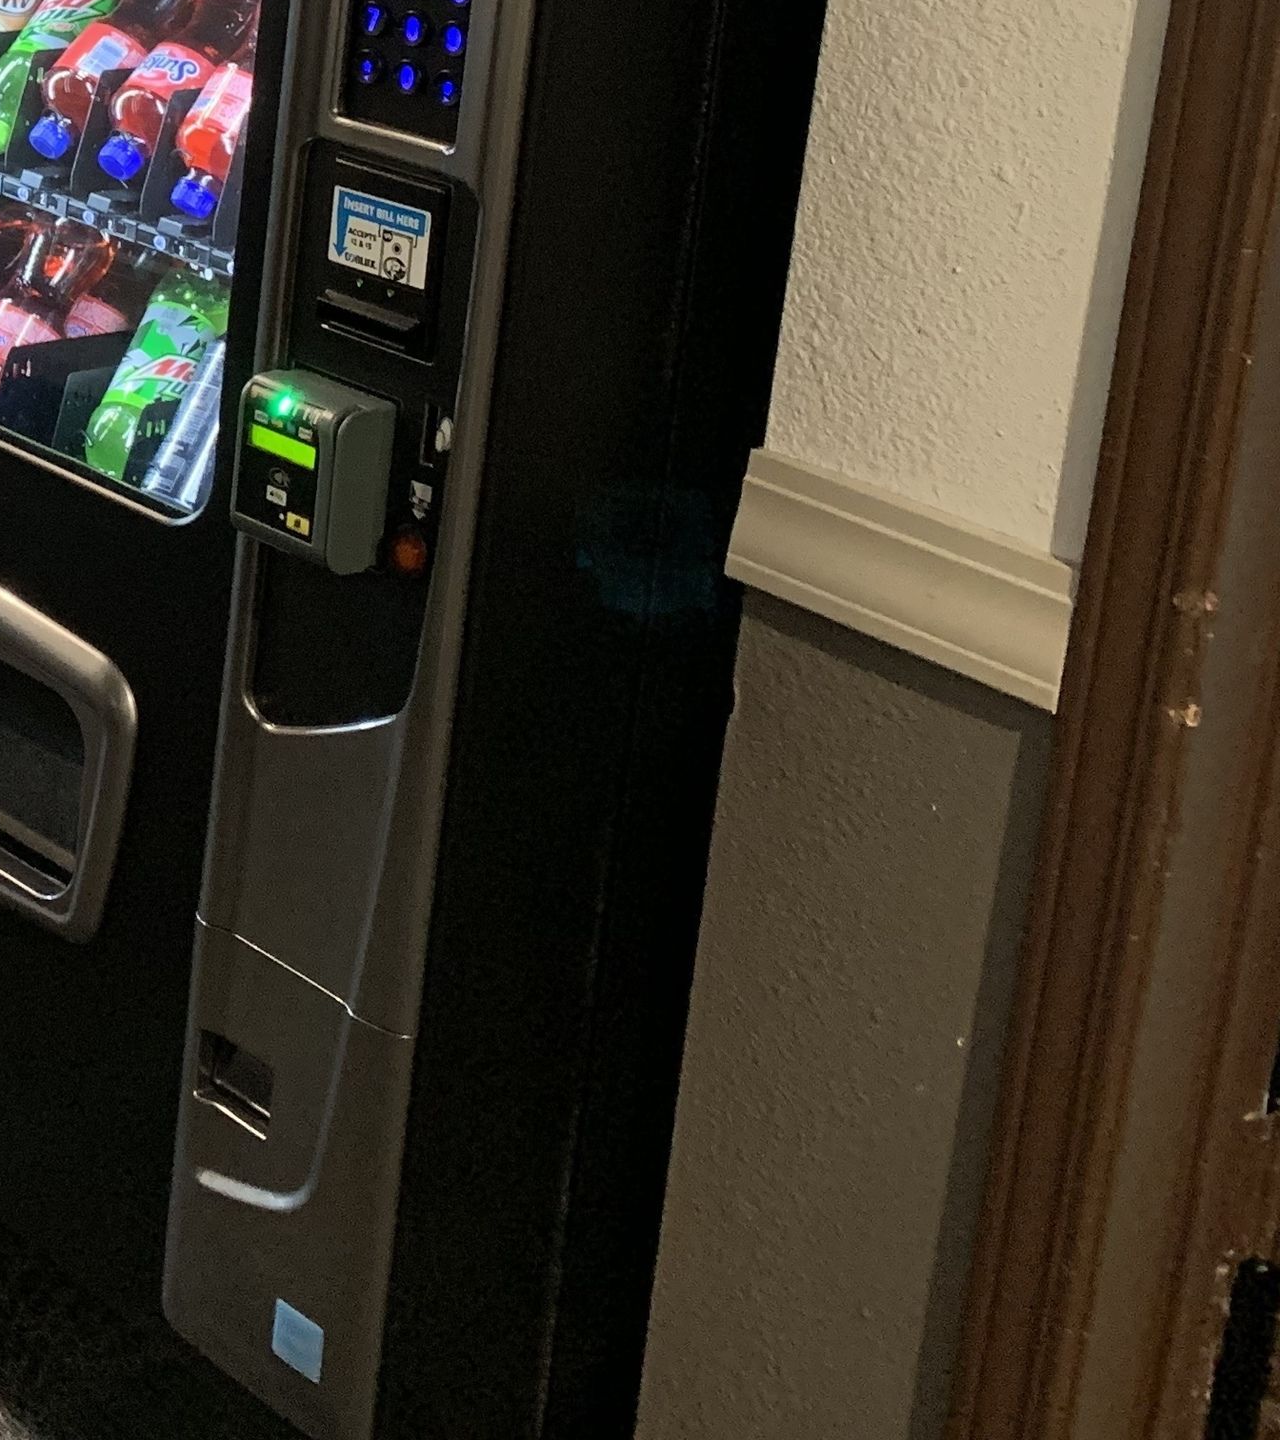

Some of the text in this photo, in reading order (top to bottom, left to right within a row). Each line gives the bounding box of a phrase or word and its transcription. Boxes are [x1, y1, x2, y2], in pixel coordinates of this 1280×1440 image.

[366, 7, 381, 32] 7
[398, 64, 414, 90] 0
[343, 196, 420, 230] INSERT BILL HERE
[348, 228, 378, 242] ACCEPTS
